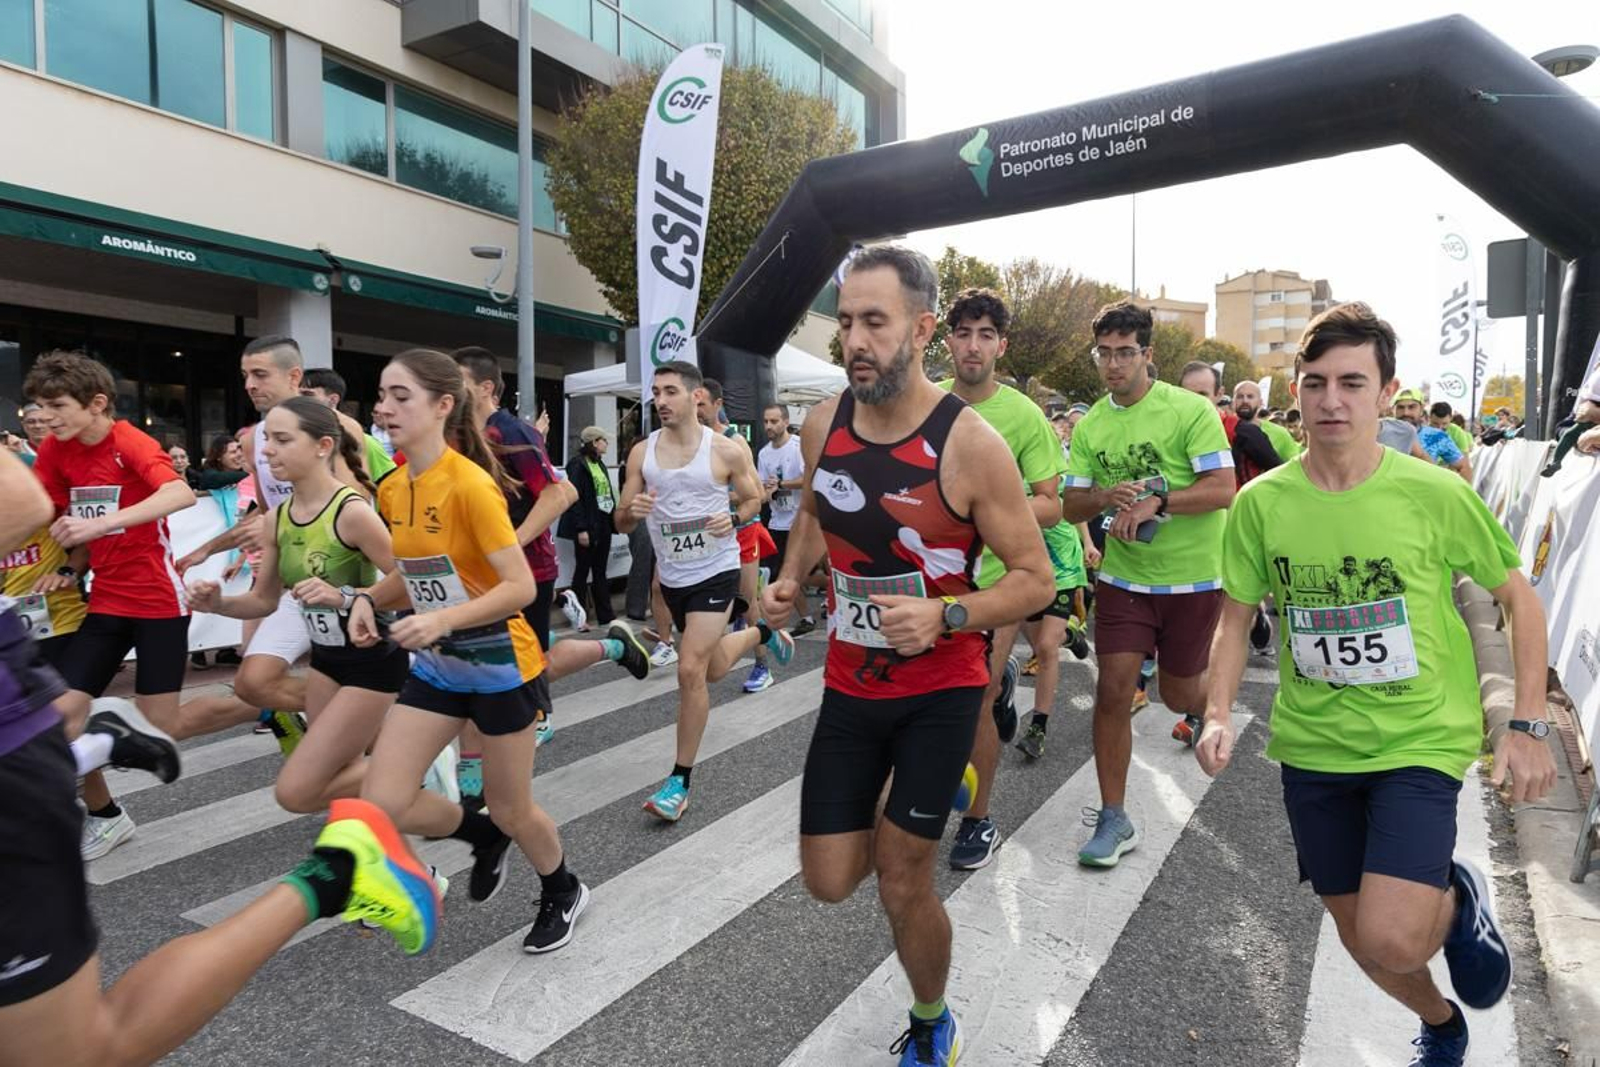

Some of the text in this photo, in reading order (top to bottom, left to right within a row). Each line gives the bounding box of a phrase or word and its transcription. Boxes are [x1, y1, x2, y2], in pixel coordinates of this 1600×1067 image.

[668, 89, 712, 111] CSIF
[1000, 105, 1194, 158] Patronato Municipal de
[1000, 134, 1148, 178] Deportes de Jaén
[650, 157, 705, 290] CSIF
[659, 331, 687, 351] CSIF
[672, 533, 705, 553] 244
[409, 580, 447, 602] 350
[1314, 632, 1388, 666] 155
